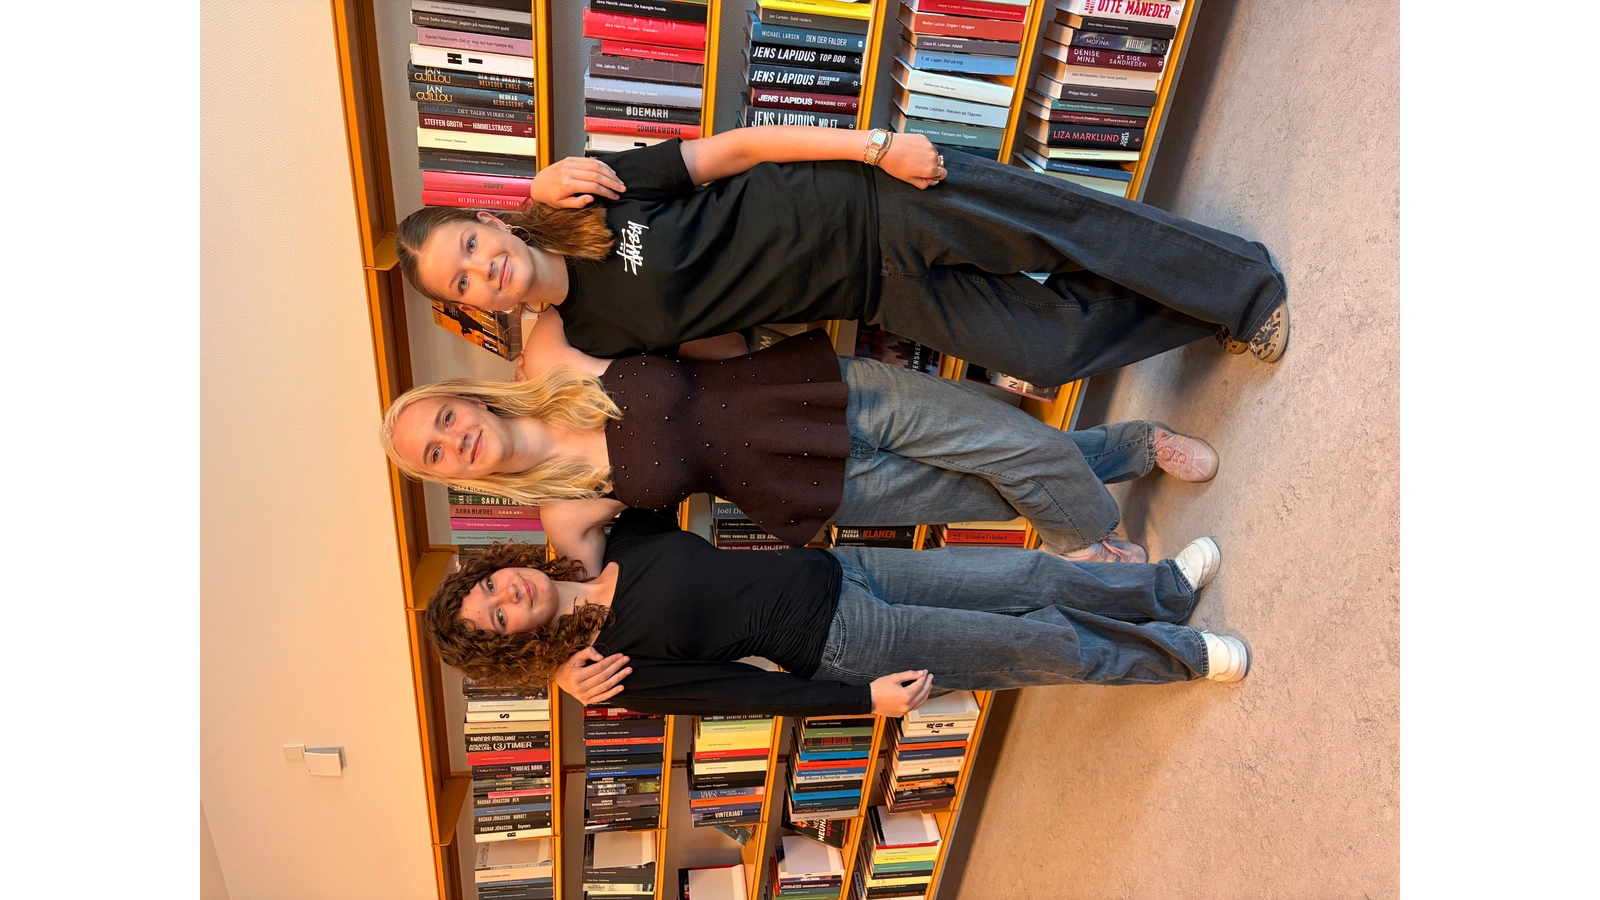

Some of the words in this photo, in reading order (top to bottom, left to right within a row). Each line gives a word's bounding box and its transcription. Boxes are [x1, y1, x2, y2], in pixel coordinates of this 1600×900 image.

[753, 46, 776, 59] JENS
[778, 49, 816, 62] LAPIDUS
[833, 55, 846, 64] DOG
[1074, 48, 1100, 58] DENISE
[1109, 58, 1147, 68] SANDHEDEN
[425, 66, 441, 75] JAN
[414, 72, 451, 84] GUILLOU
[751, 70, 776, 82] JENS
[776, 72, 815, 86] LAPIDUS
[426, 85, 442, 94] JAN
[416, 92, 453, 102] GUILLOU
[758, 94, 779, 103] JENS
[780, 97, 813, 105] LAPIDUS
[751, 111, 775, 127] JENS
[778, 113, 815, 127] LAPIDUS
[424, 118, 445, 127] STEFFEN
[446, 120, 462, 128] GROTH
[473, 122, 513, 132] HIMMELSTRASSE
[637, 125, 682, 135] SOMMERMØRKE
[1053, 130, 1070, 139] LIZA
[1072, 132, 1119, 142] MARKLUND
[863, 530, 897, 538] KLANEN
